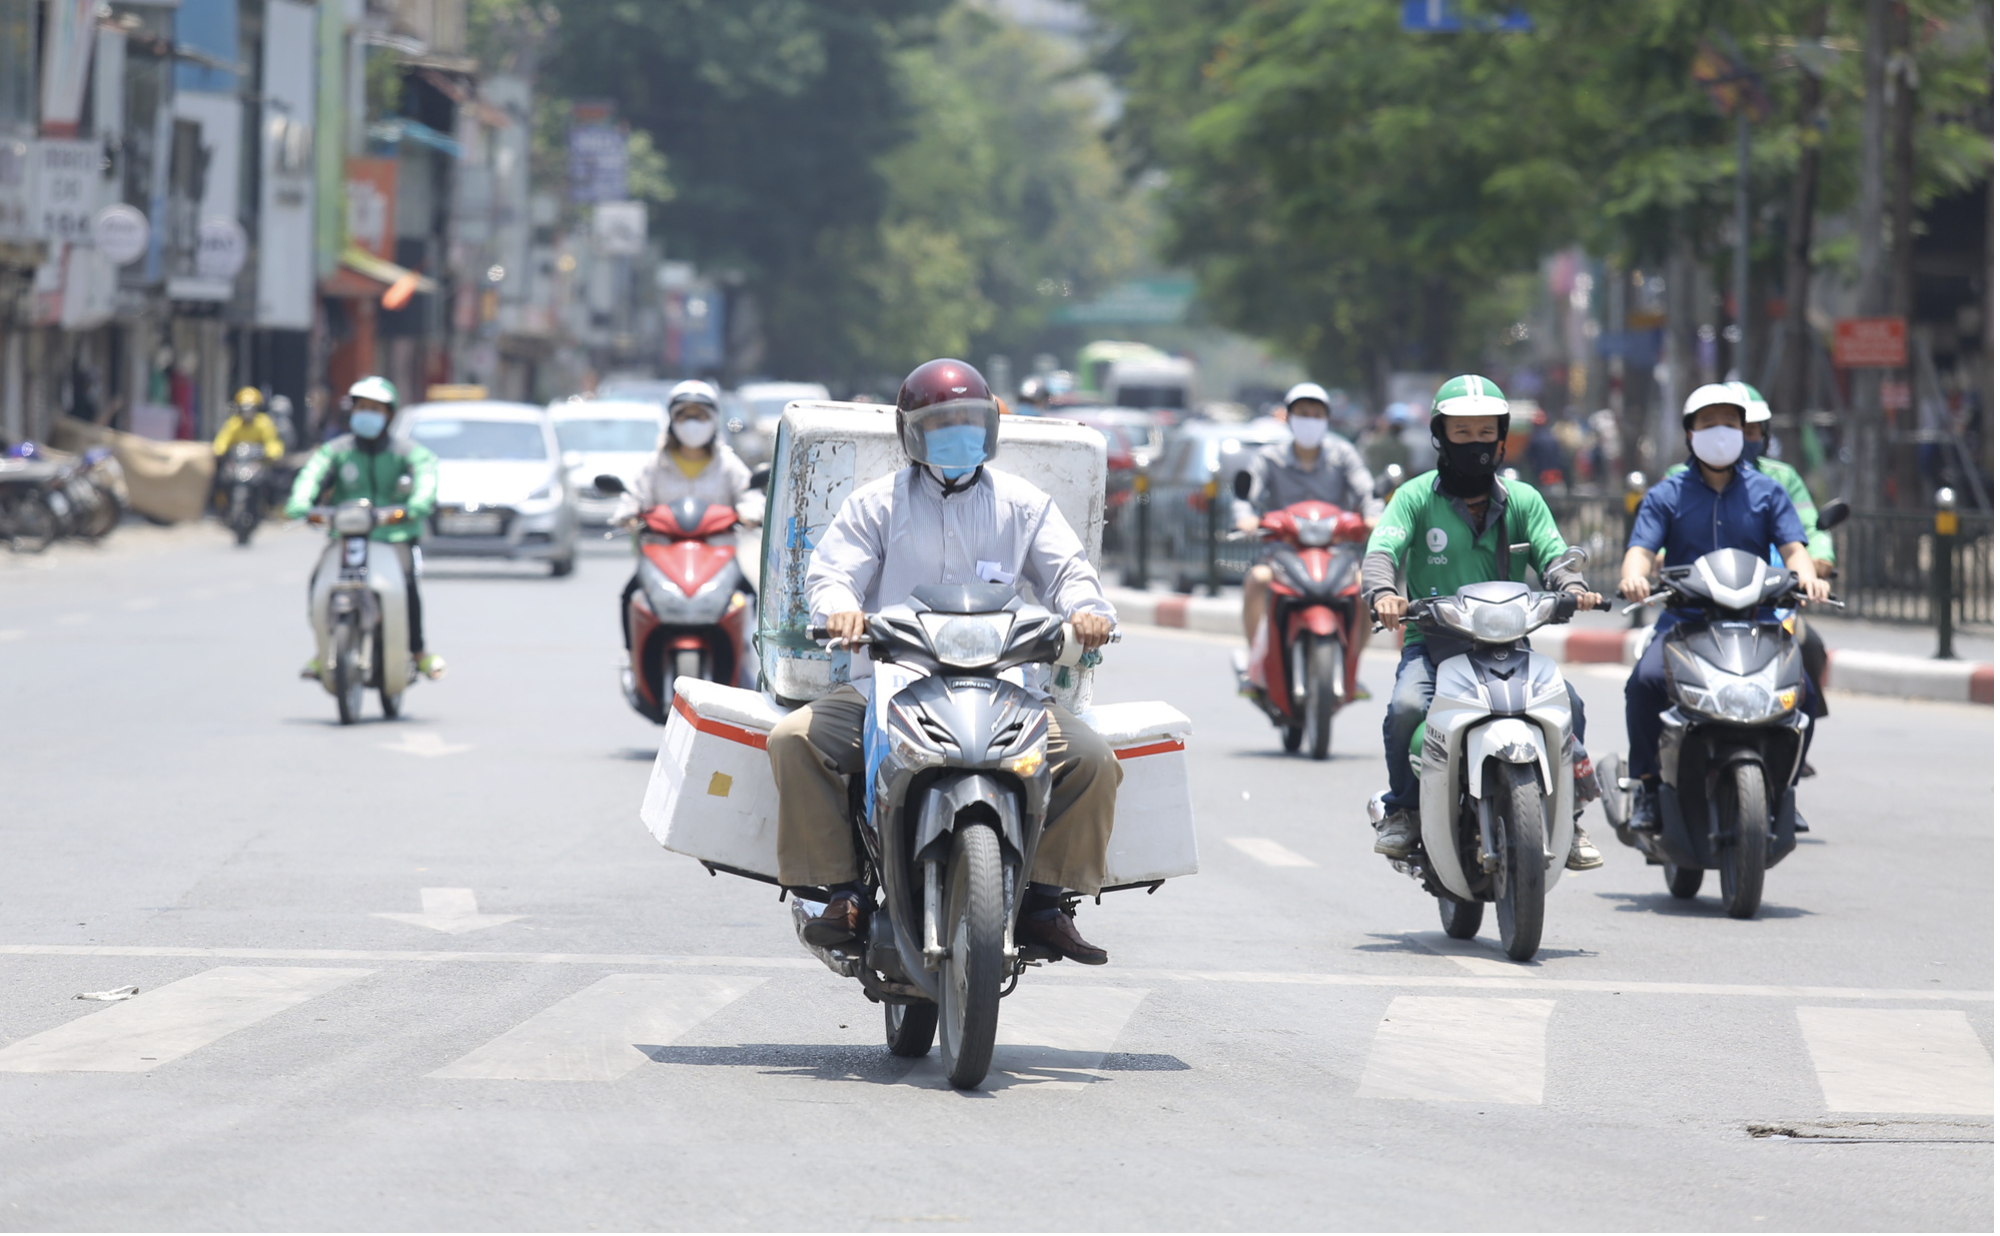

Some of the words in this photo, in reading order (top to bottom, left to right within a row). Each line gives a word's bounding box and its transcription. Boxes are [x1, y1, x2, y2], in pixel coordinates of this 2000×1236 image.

[1374, 525, 1406, 540] Grab
[1427, 554, 1448, 565] Grab
[954, 680, 991, 689] HONDA
